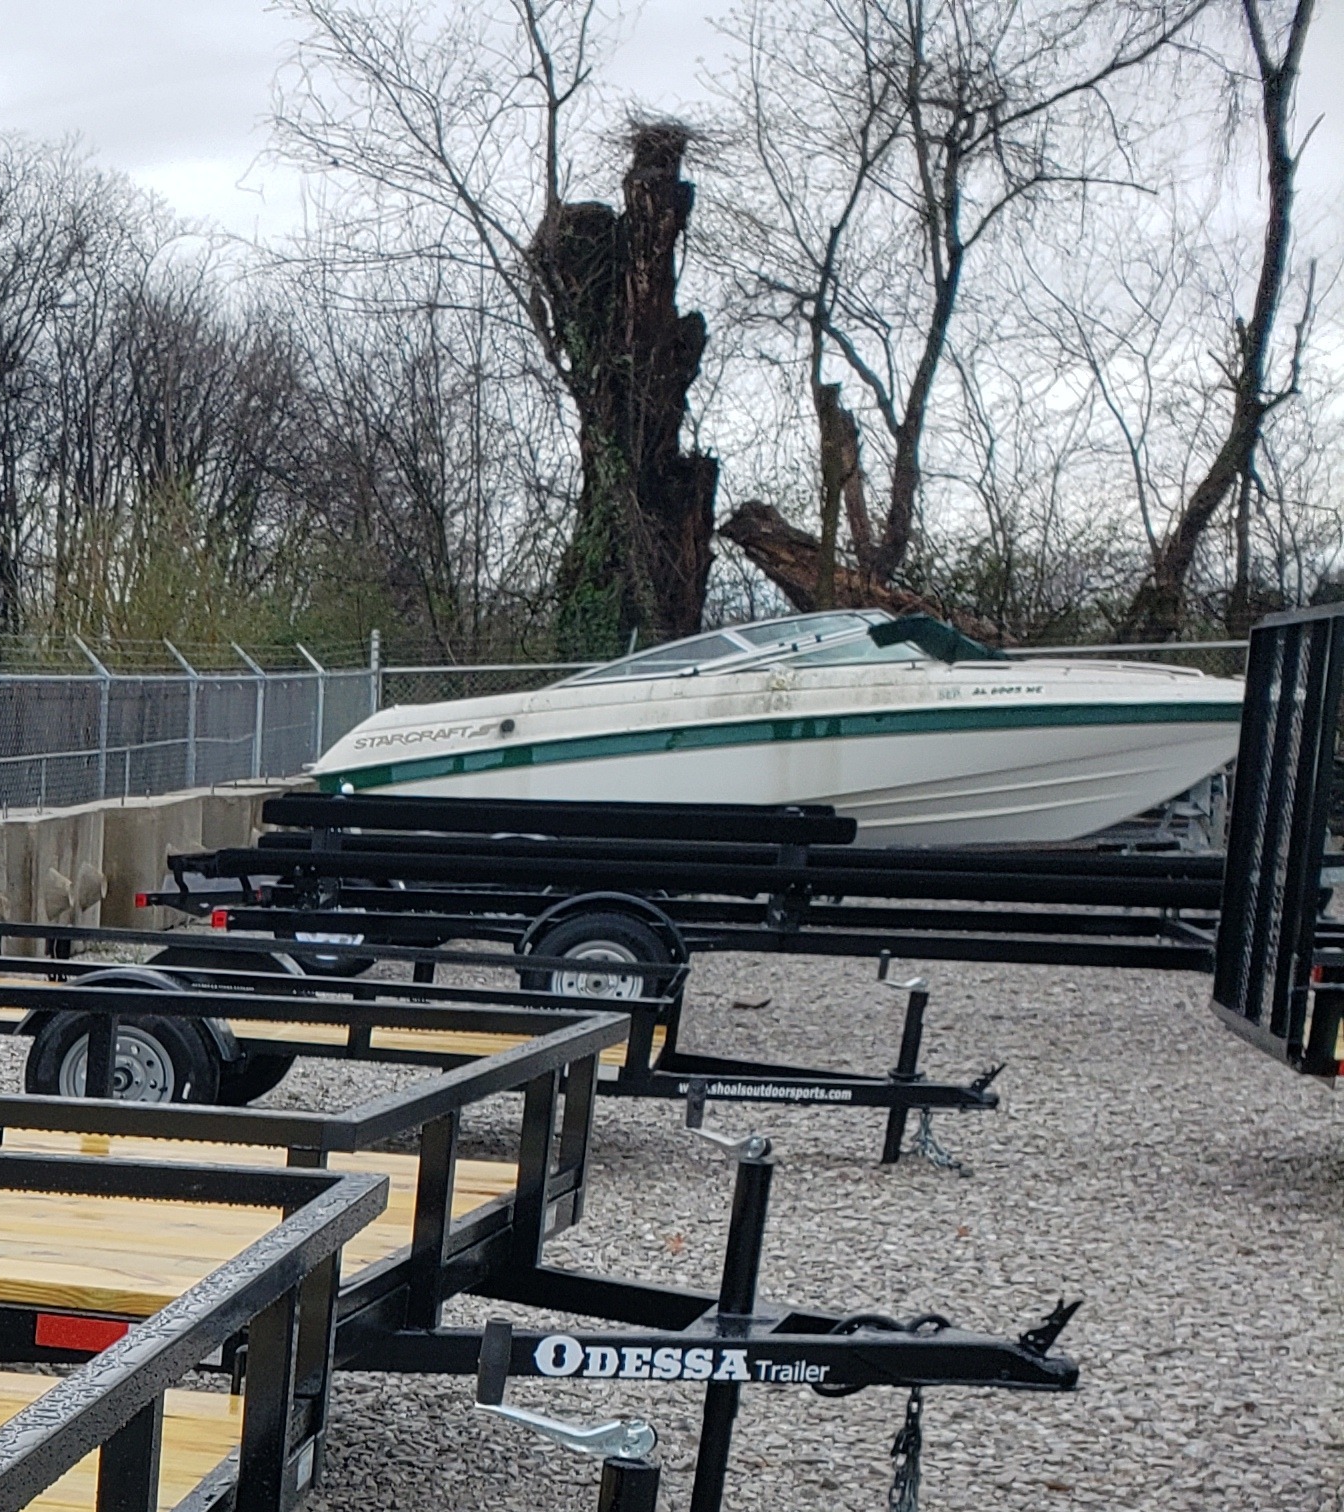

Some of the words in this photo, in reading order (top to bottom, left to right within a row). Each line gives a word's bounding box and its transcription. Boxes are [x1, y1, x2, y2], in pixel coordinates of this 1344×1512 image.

[354, 726, 472, 750] STARCRAFT
[679, 1081, 852, 1101] w.shoalsoutdoorsports.com
[533, 1335, 751, 1380] ODESSA
[756, 1360, 830, 1382] Trailer
